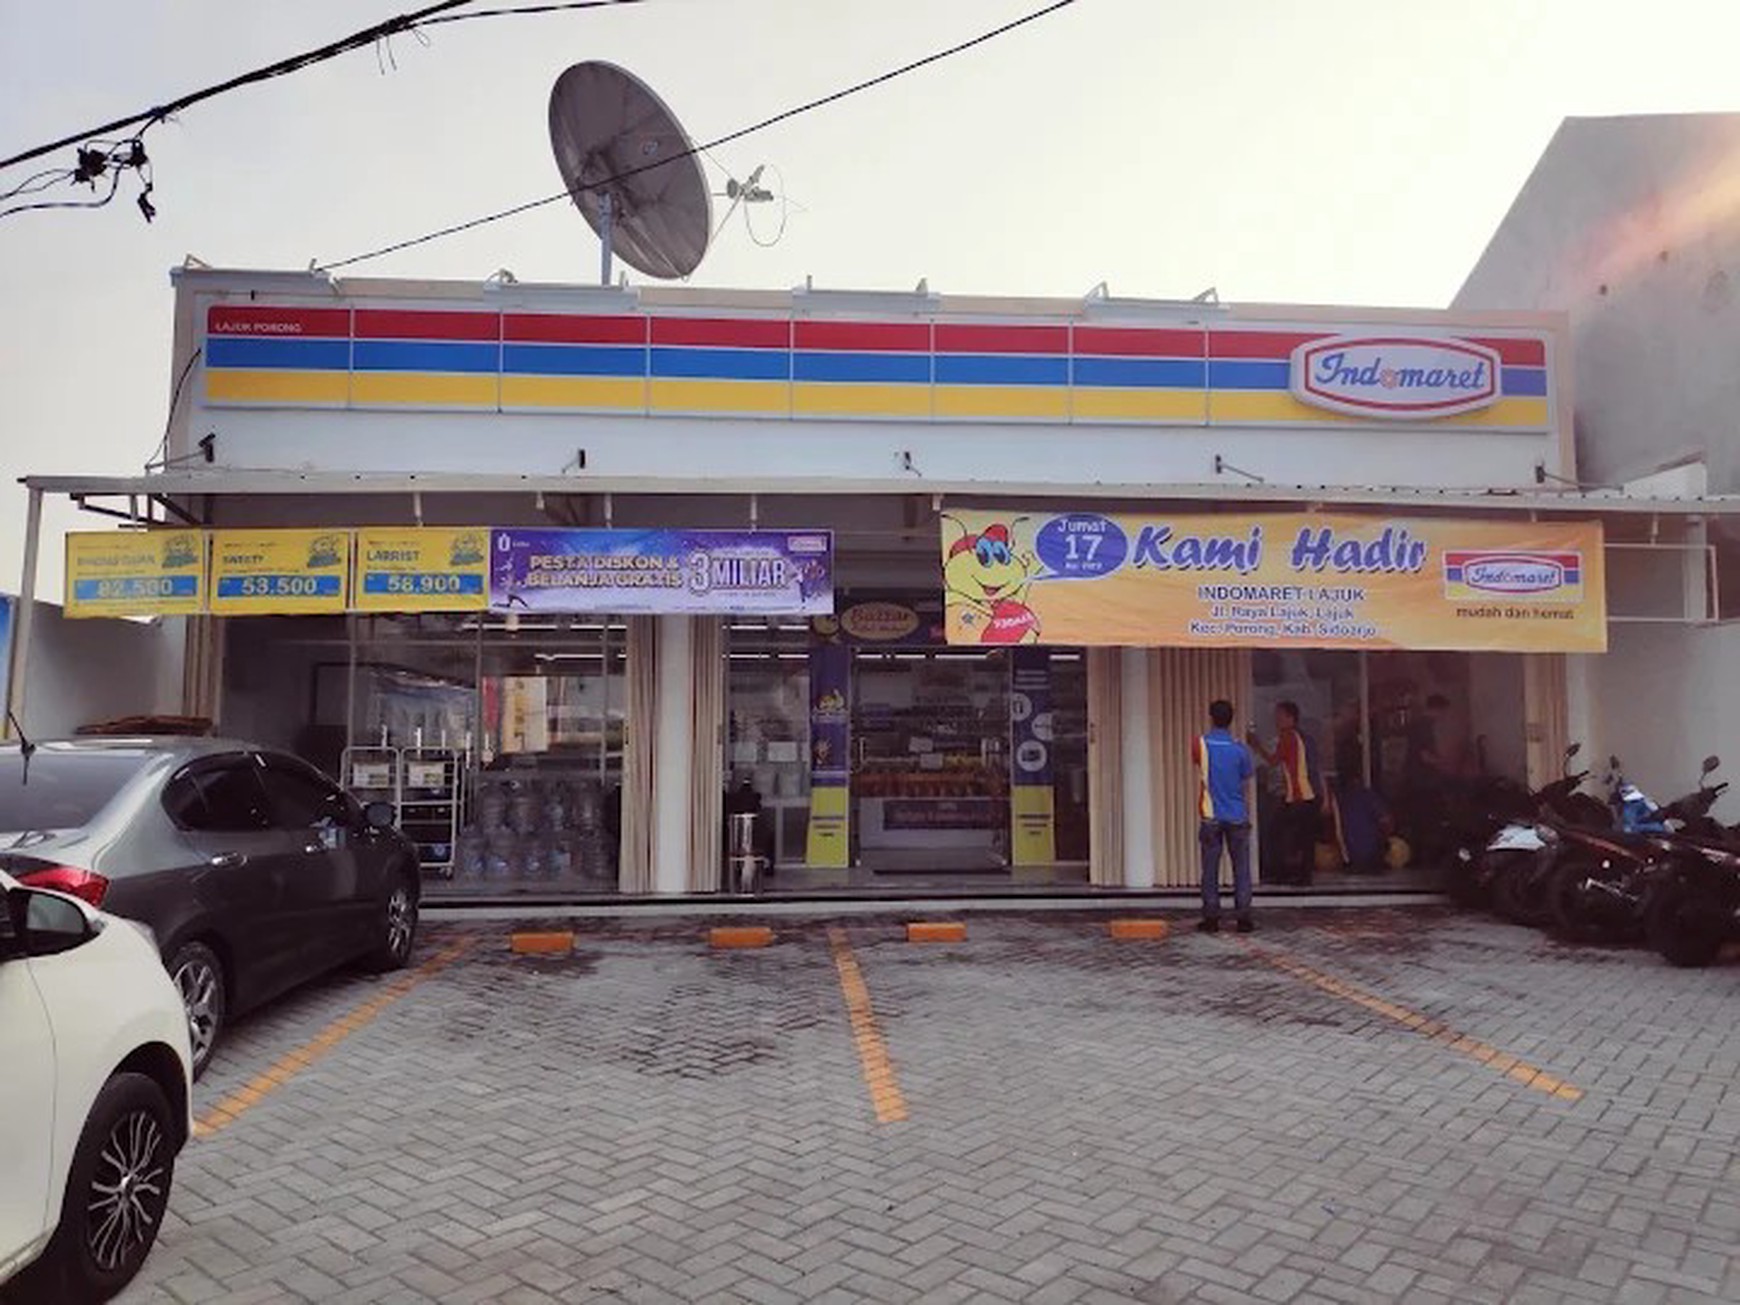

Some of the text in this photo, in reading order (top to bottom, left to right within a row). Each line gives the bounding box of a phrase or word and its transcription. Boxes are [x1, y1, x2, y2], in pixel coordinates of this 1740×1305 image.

[253, 322, 302, 334] PORONG
[1315, 352, 1485, 390] Indomaret
[1057, 518, 1107, 533] Jumat
[1065, 533, 1103, 561] 17
[1133, 525, 1424, 573] Kami Hadir
[530, 555, 591, 570] PESTA
[595, 555, 663, 570] DISKON
[527, 571, 683, 588] BELANJA GRATIS
[690, 552, 787, 592] 3 MILIAR
[1471, 566, 1556, 584] Indomaret
[241, 577, 317, 595] 53.500
[1198, 586, 1302, 600] INDOMARET
[1456, 606, 1501, 619] mudah
[1504, 607, 1530, 619] dan
